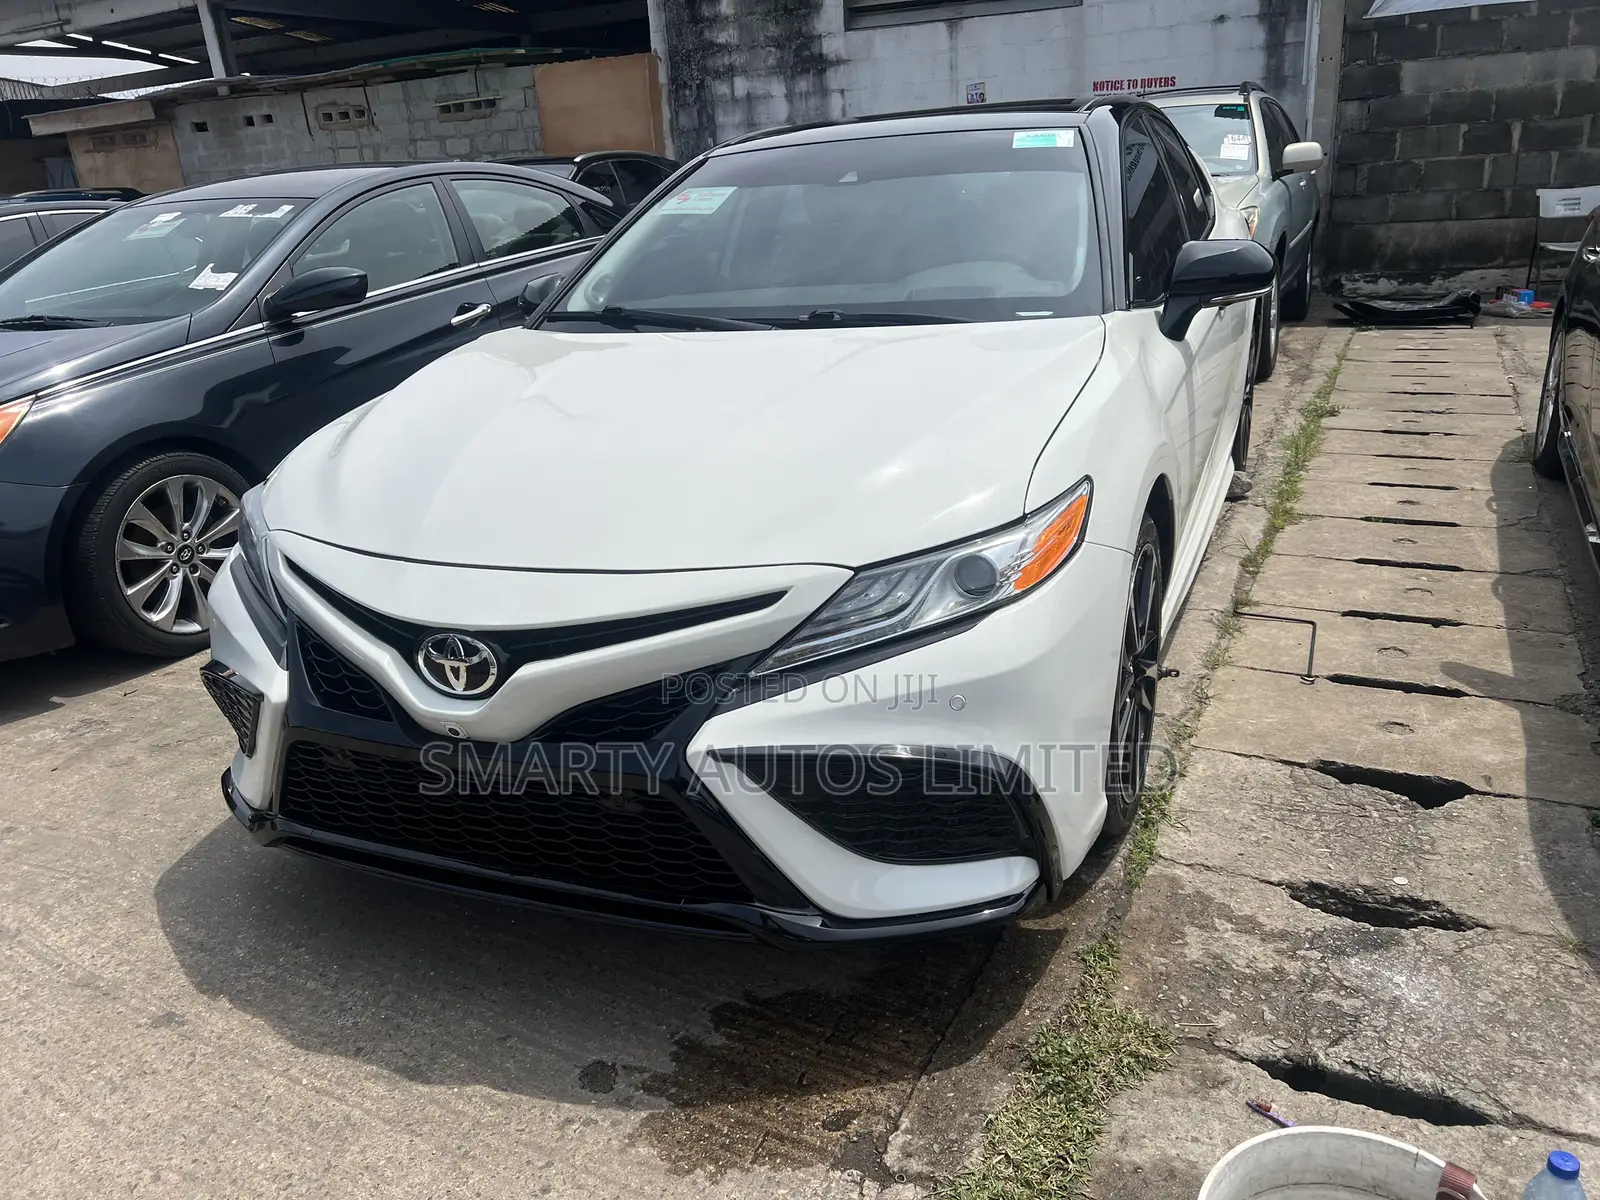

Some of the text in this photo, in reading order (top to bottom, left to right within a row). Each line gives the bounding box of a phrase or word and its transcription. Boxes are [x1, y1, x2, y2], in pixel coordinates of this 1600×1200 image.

[1092, 76, 1176, 92] NOTICE TO BUYERS
